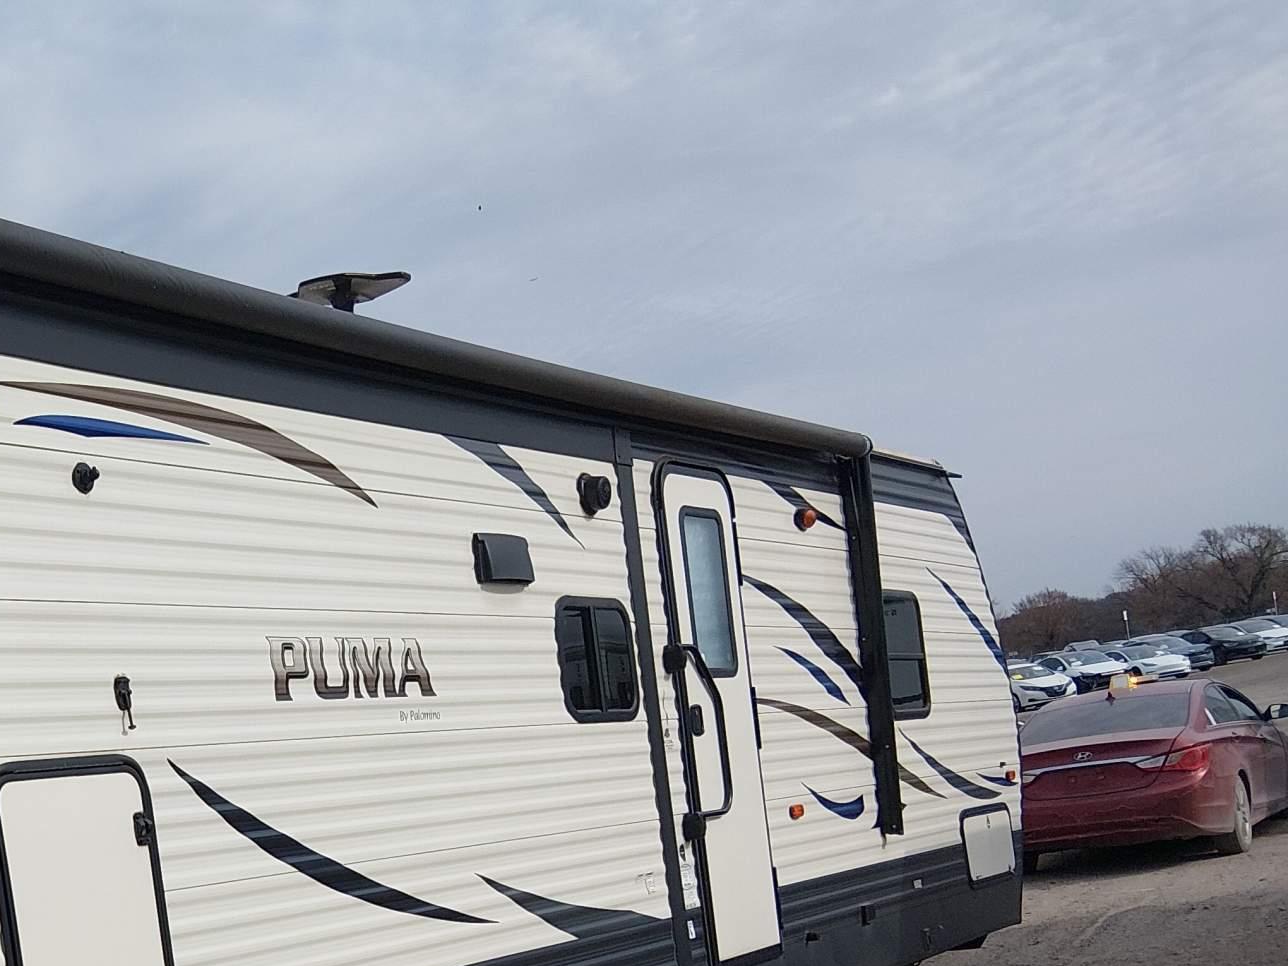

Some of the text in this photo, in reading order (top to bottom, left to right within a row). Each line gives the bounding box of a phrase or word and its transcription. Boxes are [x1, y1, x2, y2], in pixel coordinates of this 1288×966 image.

[265, 636, 438, 702] PUMA
[399, 708, 441, 723] By Palomino
